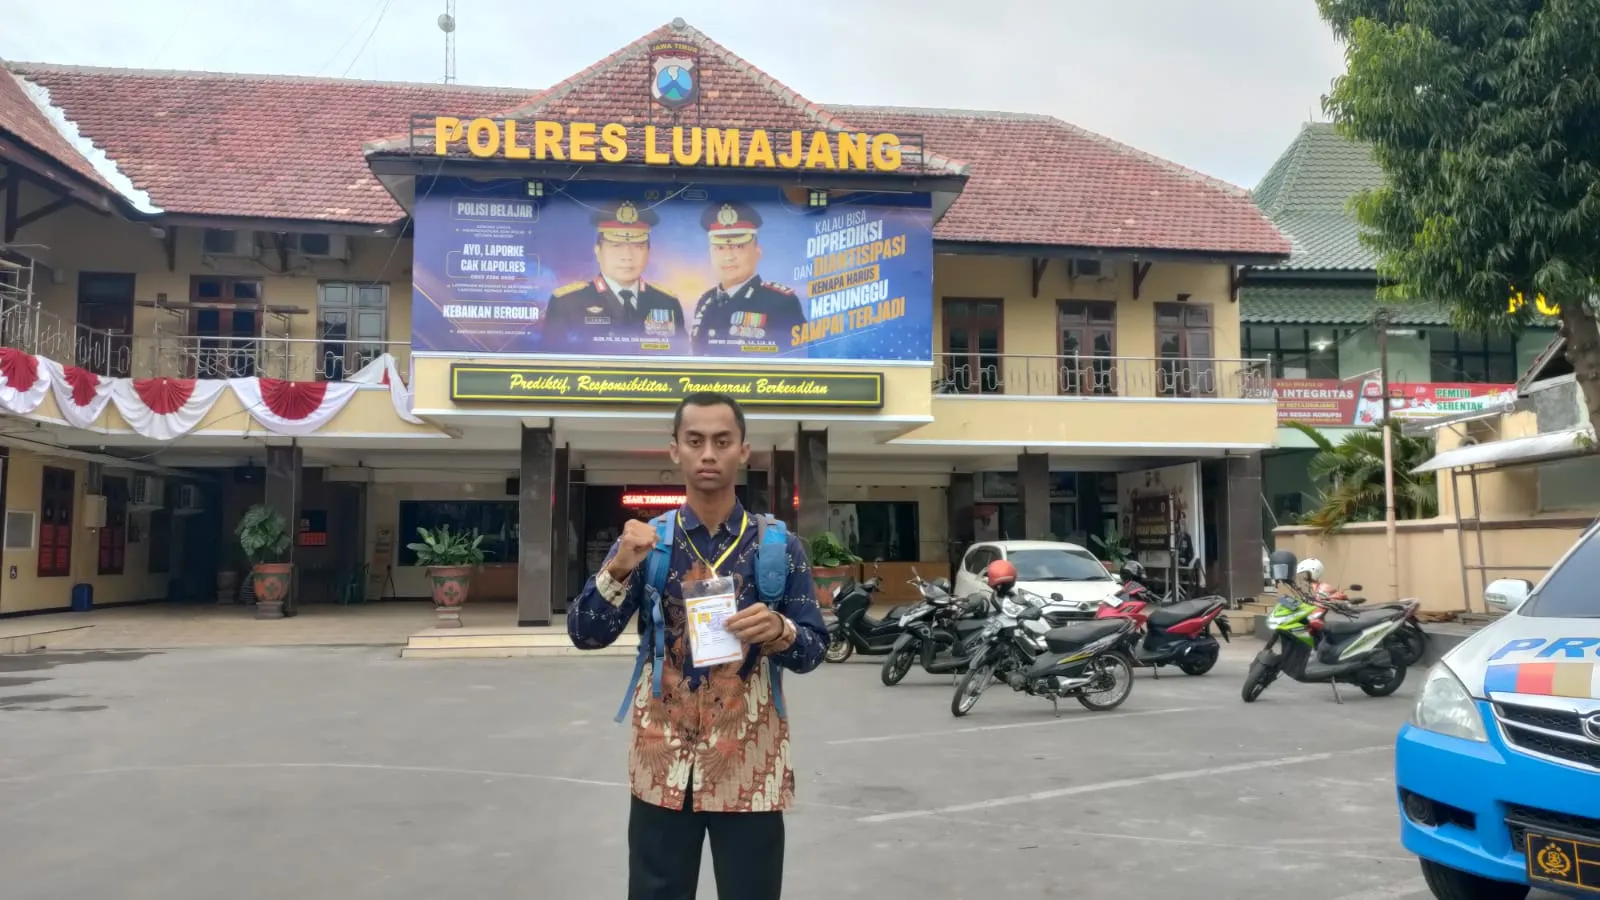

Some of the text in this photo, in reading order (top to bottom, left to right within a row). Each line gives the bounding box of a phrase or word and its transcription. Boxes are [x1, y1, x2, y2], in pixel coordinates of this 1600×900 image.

[652, 43, 672, 51] JAWA
[435, 116, 902, 171] POLRES LUMAJANG
[458, 202, 533, 218] POLISI BELAJAR
[816, 210, 867, 234] KALAU BISA
[806, 220, 883, 258] DIPREDIKSI
[463, 244, 525, 257] AYO, LAPORKE
[794, 234, 906, 281] DAN DIANTISIPASI
[461, 260, 526, 273] CAK KAPOLRES
[811, 267, 875, 294] KENAPA HARUS
[811, 279, 888, 319] MENUNGGU
[443, 304, 539, 320] KEBAIKAN BERGULIR
[791, 296, 906, 346] SAMPAI TERJADI
[679, 377, 752, 394] Transparasi
[755, 379, 830, 395] Berkeadilan
[1283, 389, 1354, 399] INTEGRITAS
[1435, 388, 1471, 398] PEMILU
[1489, 637, 1600, 660] PR
